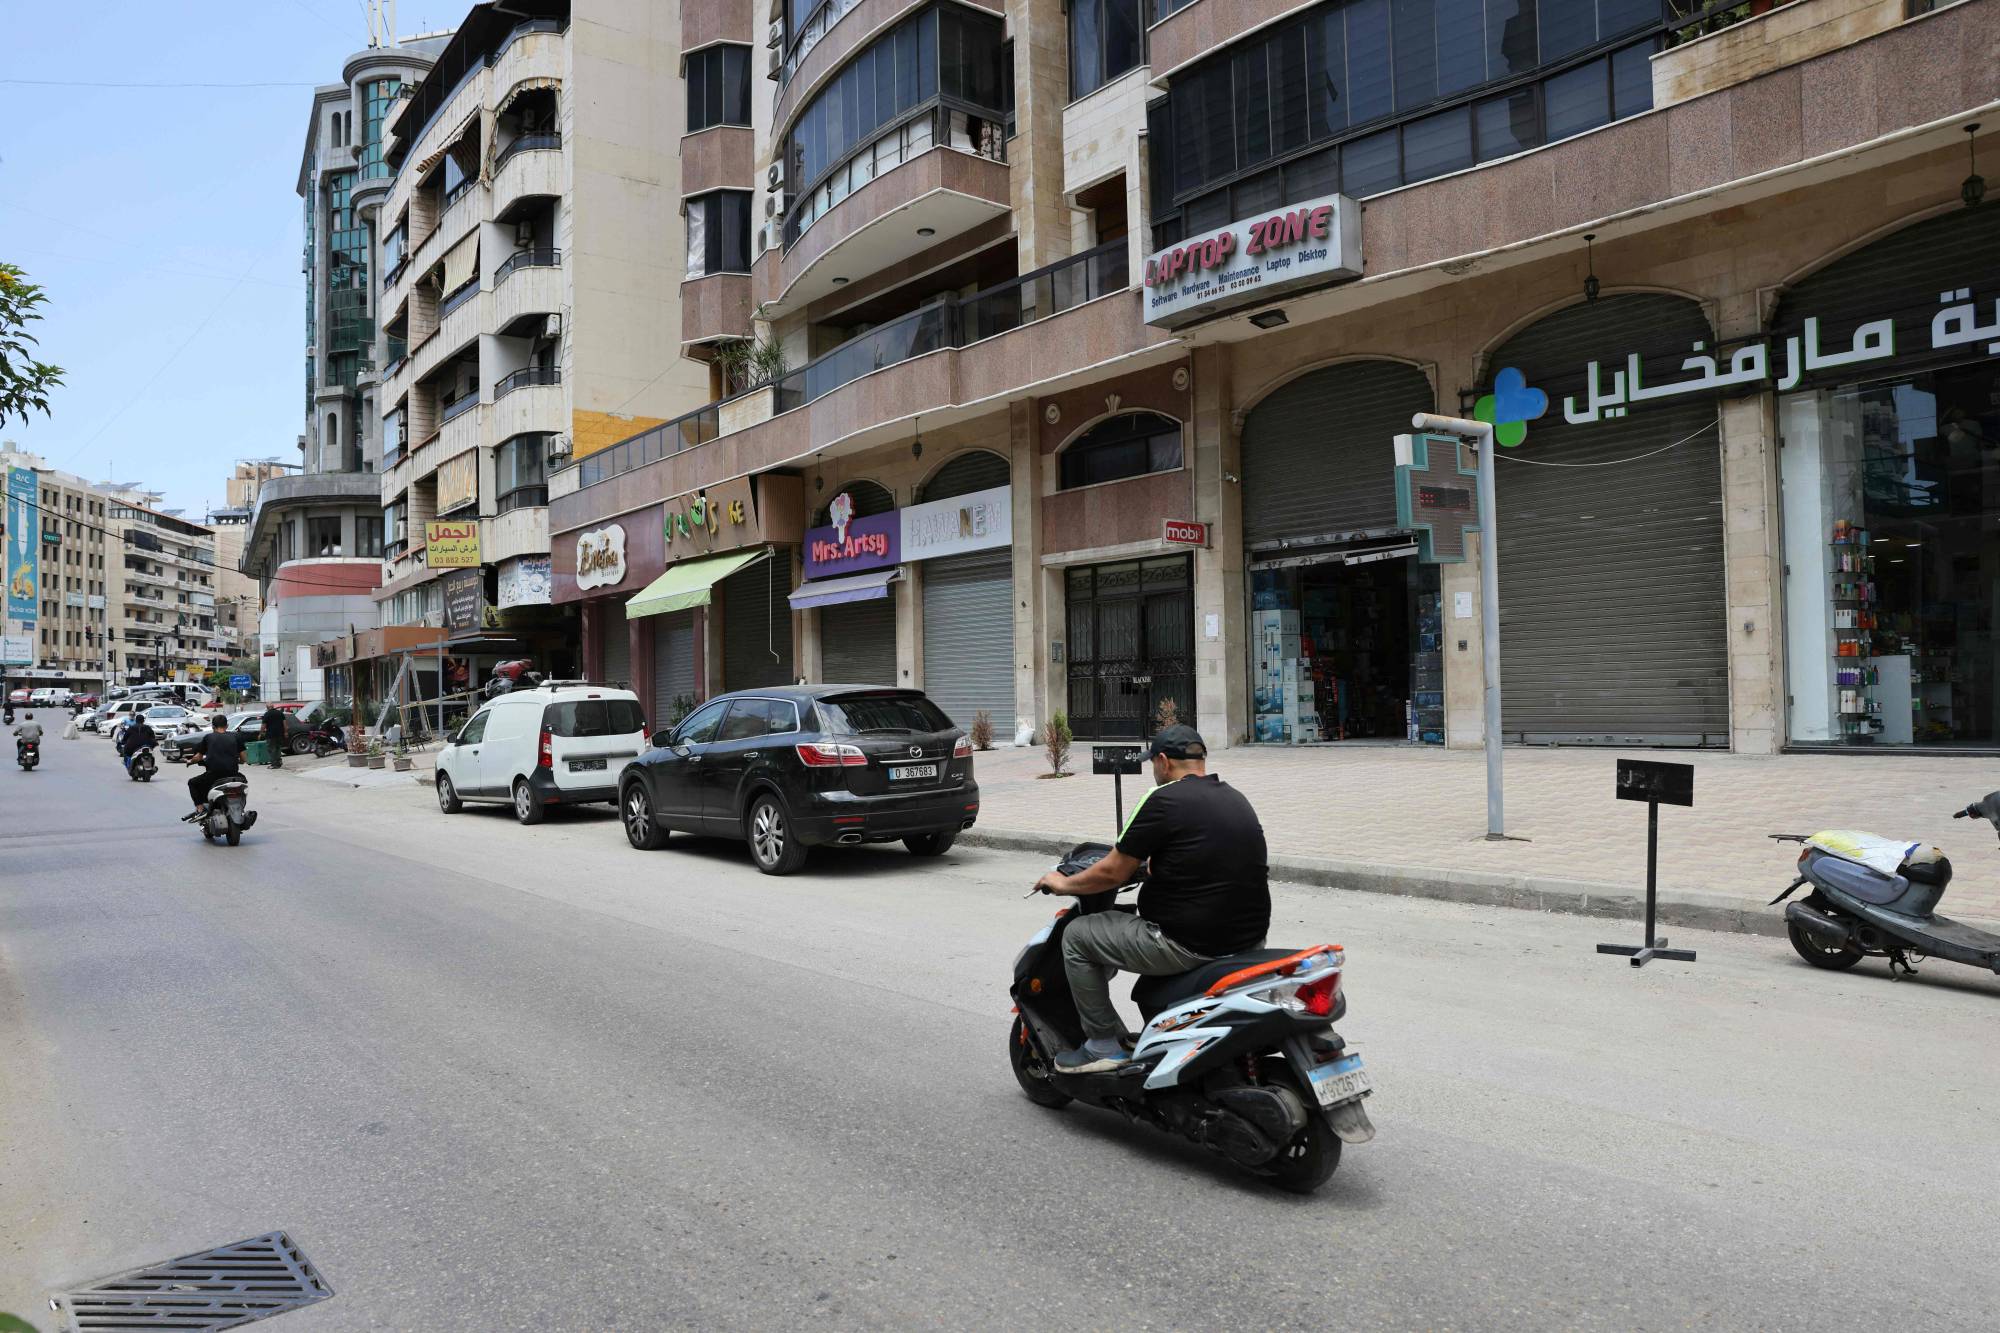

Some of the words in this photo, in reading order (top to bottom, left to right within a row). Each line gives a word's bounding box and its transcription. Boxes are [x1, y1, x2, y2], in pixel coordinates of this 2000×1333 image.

[1145, 231, 1234, 288] LAPTOP
[1246, 205, 1334, 256] ZONE
[1151, 291, 1178, 308] Software
[1182, 280, 1210, 296] Hardware
[1218, 265, 1260, 285] Maintenance
[1266, 257, 1291, 272] Laptop
[1778, 317, 1893, 390] مار
[1563, 341, 1769, 424] مخايل
[428, 524, 476, 543] الجمل
[430, 545, 458, 554] السيارات
[460, 544, 478, 554] فرش
[812, 540, 842, 562] Mrs.
[844, 533, 885, 558] Artsy
